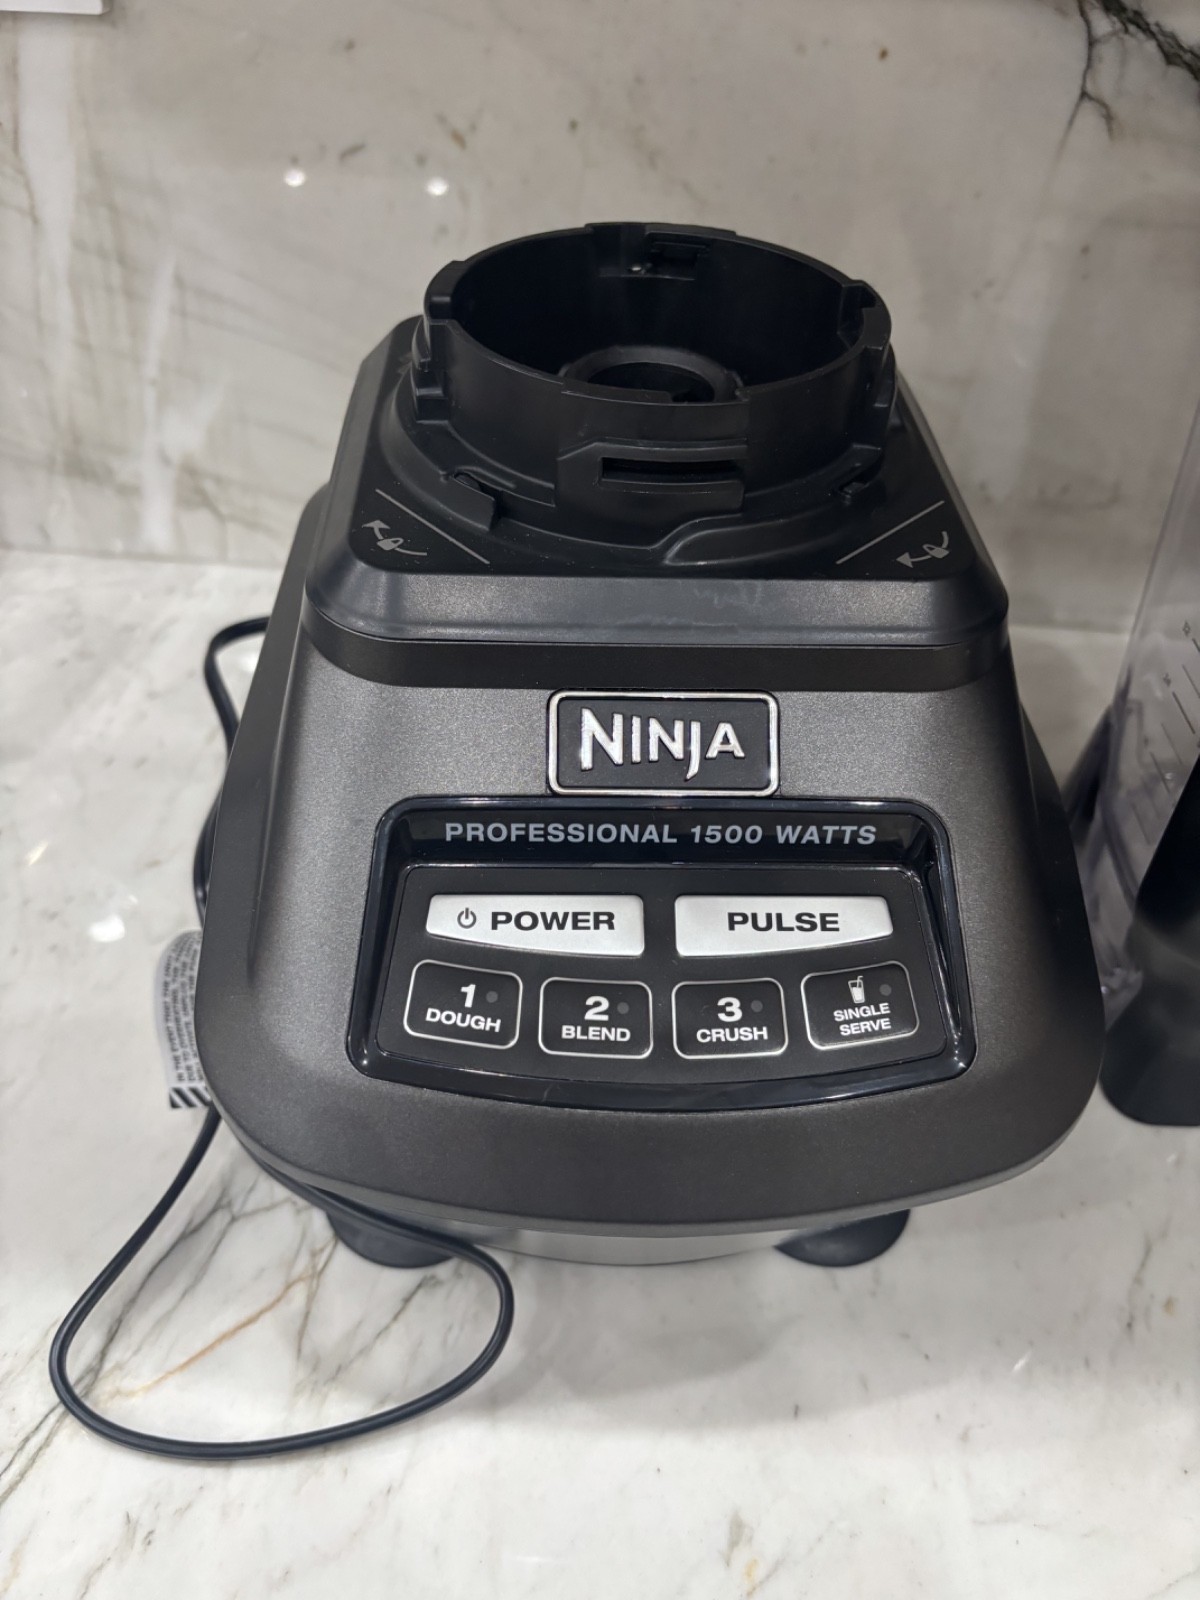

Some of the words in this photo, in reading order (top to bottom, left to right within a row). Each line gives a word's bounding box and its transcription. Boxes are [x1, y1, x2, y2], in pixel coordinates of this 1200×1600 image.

[580, 707, 746, 781] NINJA
[445, 822, 678, 844] PROFESSIONAL
[690, 824, 764, 845] 1500
[776, 825, 878, 846] WATTS
[490, 911, 616, 931] POWER
[727, 912, 840, 932] PULSE
[460, 983, 477, 1009] 1
[584, 995, 610, 1022] 2
[717, 997, 743, 1023] 3
[833, 1002, 891, 1022] SINGLE
[425, 1007, 502, 1033] DOUGH
[839, 1018, 892, 1036] SERVE
[561, 1024, 632, 1042] BLEND
[696, 1026, 769, 1044] CRUSH
